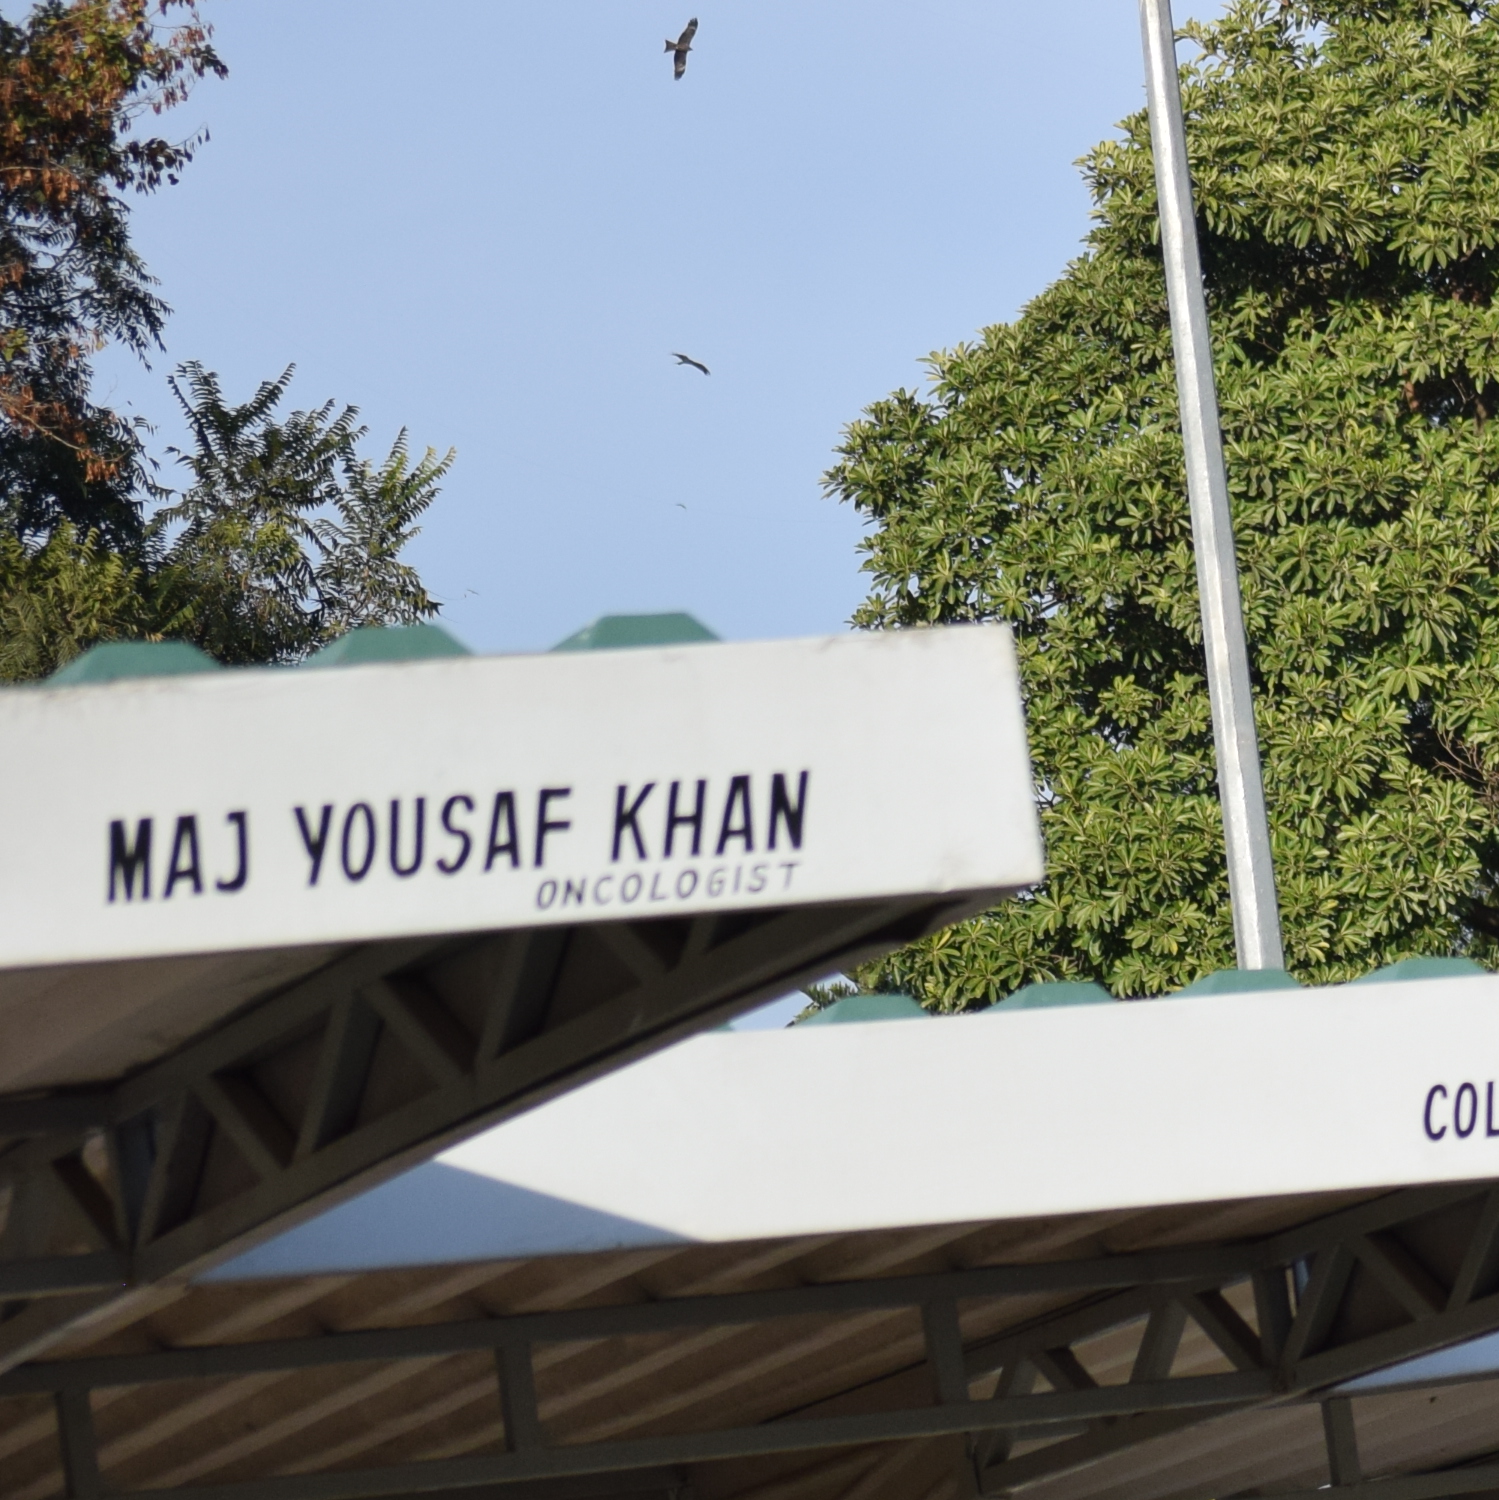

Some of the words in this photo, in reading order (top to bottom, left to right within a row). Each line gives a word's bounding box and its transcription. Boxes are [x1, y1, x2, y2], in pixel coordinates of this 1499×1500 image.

[106, 810, 250, 904] MAJ
[292, 786, 574, 887] YOUSAF
[610, 769, 810, 865] KHAN
[534, 861, 804, 911] ONCOLOGIST
